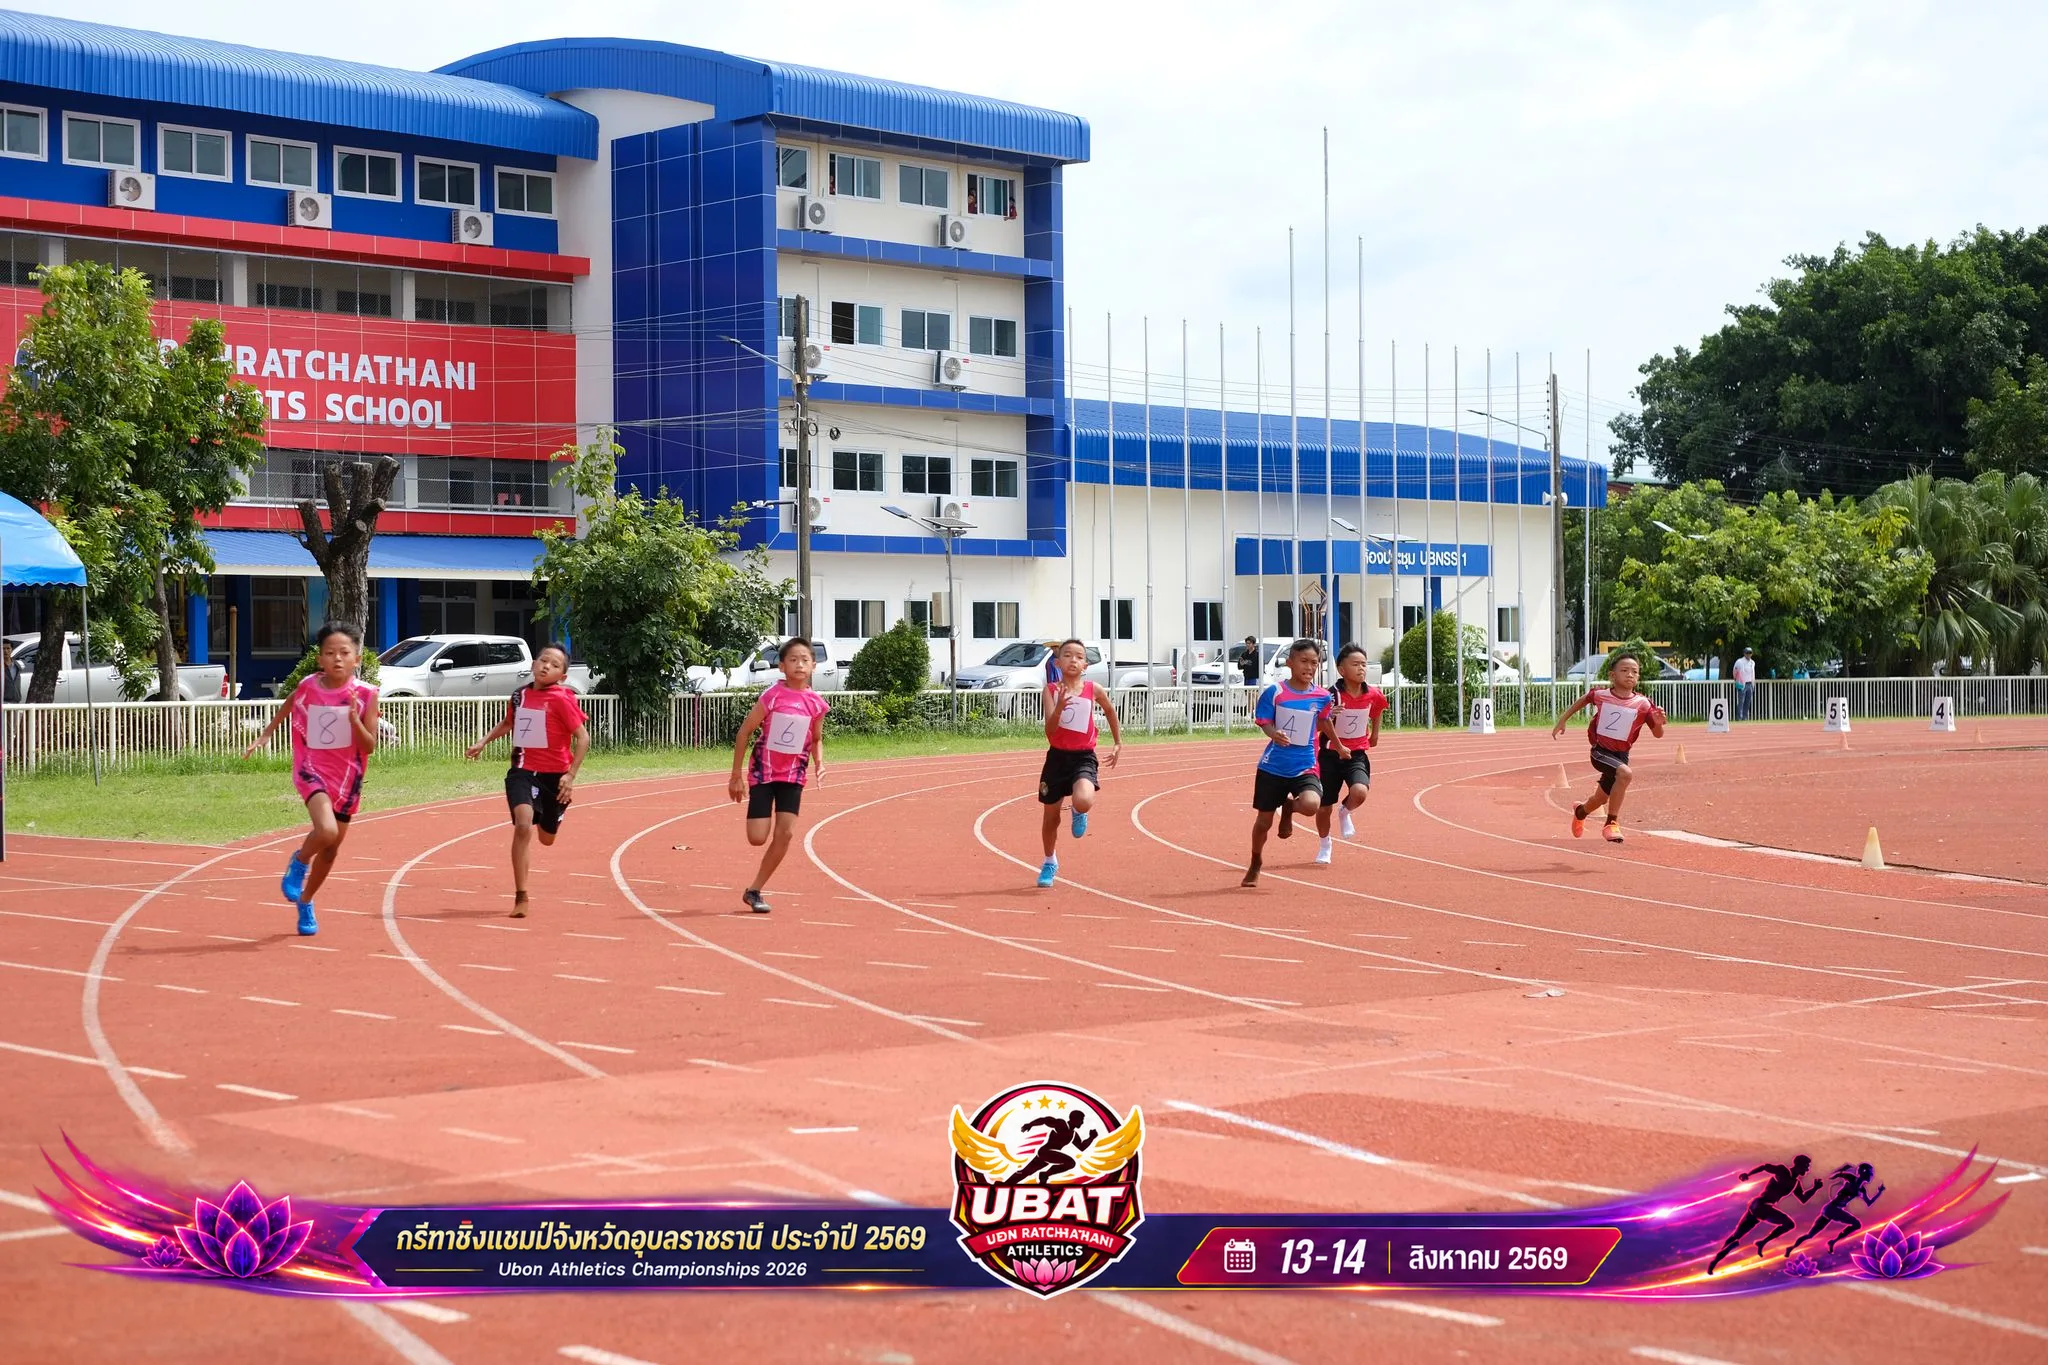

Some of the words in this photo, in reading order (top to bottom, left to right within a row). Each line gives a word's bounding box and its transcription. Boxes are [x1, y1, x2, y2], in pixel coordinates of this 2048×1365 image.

[324, 393, 453, 430] SCHOOL
[1461, 552, 1468, 567] 1
[1474, 703, 1481, 720] 8
[1485, 704, 1491, 720] 8
[1714, 703, 1724, 720] 6
[1830, 702, 1837, 720] 5
[1841, 702, 1847, 720] 5
[1936, 702, 1944, 720] 4
[318, 711, 338, 745] 8
[519, 717, 533, 739] 7
[1282, 715, 1298, 738] 4
[1343, 715, 1359, 735] 3
[1605, 711, 1622, 731] 2
[781, 721, 795, 744] 6
